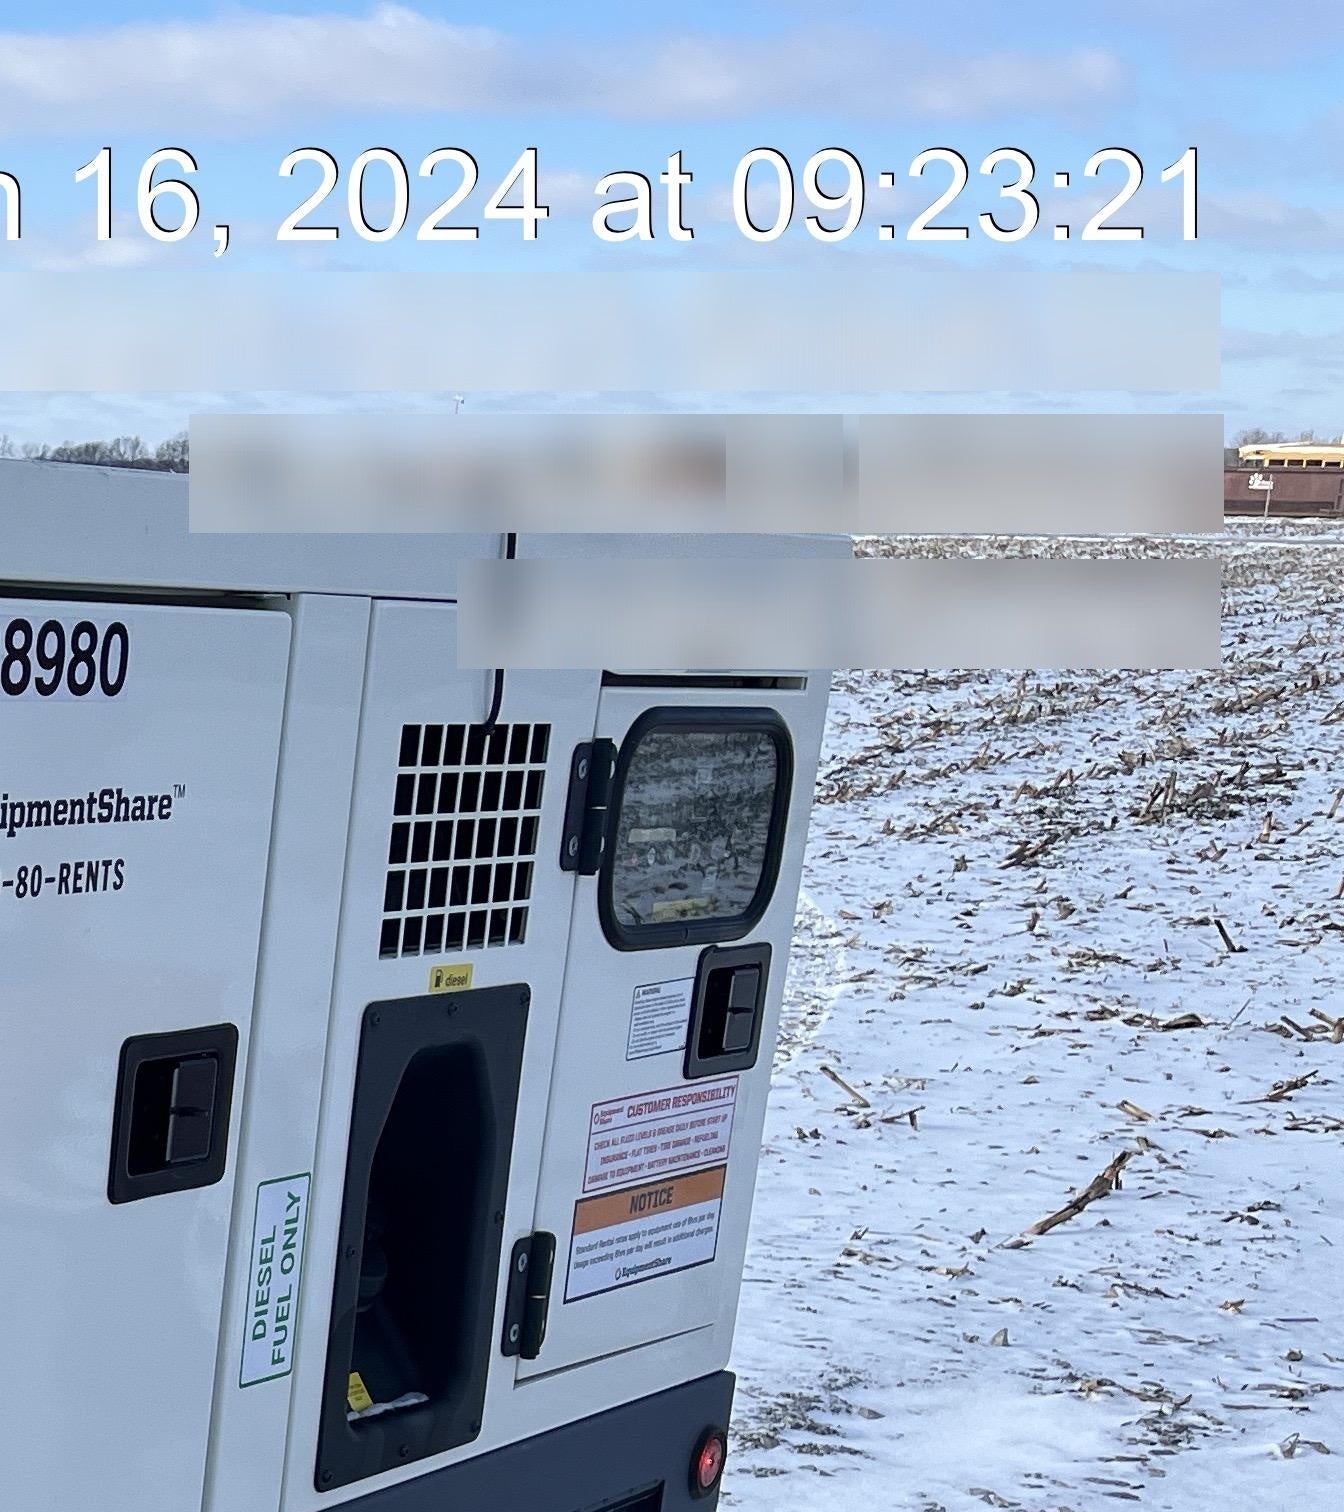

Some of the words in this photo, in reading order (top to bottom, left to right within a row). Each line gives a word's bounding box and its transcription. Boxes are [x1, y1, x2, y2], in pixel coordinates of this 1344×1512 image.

[445, 972, 469, 987] diesel
[627, 1099, 670, 1117] CUSTOMER
[672, 1086, 735, 1108] RESPONSIBILITY
[630, 1186, 674, 1214] NOTICE
[280, 1190, 301, 1276] ONLY
[622, 1256, 672, 1277] EquipmentShare
[252, 1225, 277, 1342] DIESEL
[271, 1283, 293, 1366] FUEL
